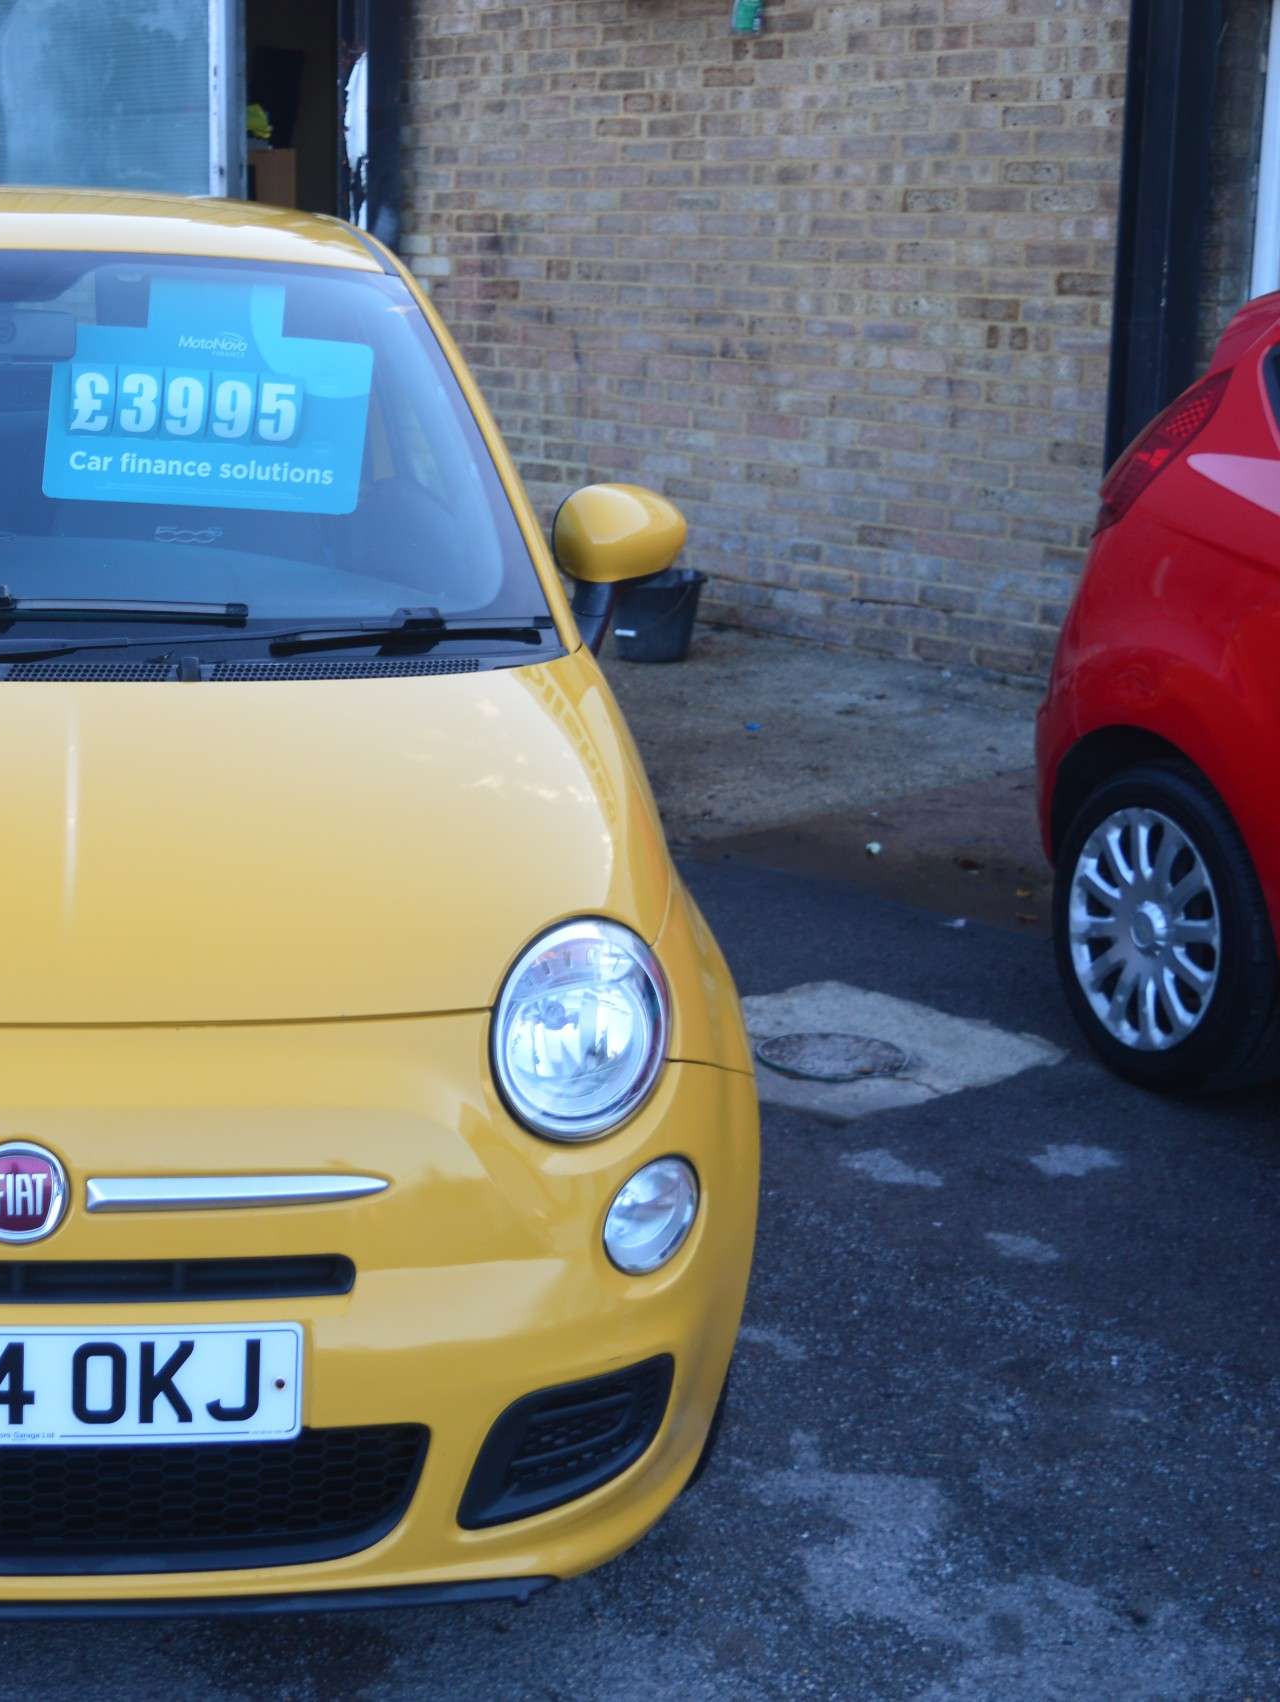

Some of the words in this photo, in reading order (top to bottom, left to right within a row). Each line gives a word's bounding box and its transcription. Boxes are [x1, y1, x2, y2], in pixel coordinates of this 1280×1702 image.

[177, 334, 248, 352] MotoNova
[69, 371, 297, 442] £3995
[68, 450, 113, 472] Car
[120, 452, 211, 477] finance
[219, 460, 334, 485] solutions
[72, 1338, 261, 1425] OKJ
